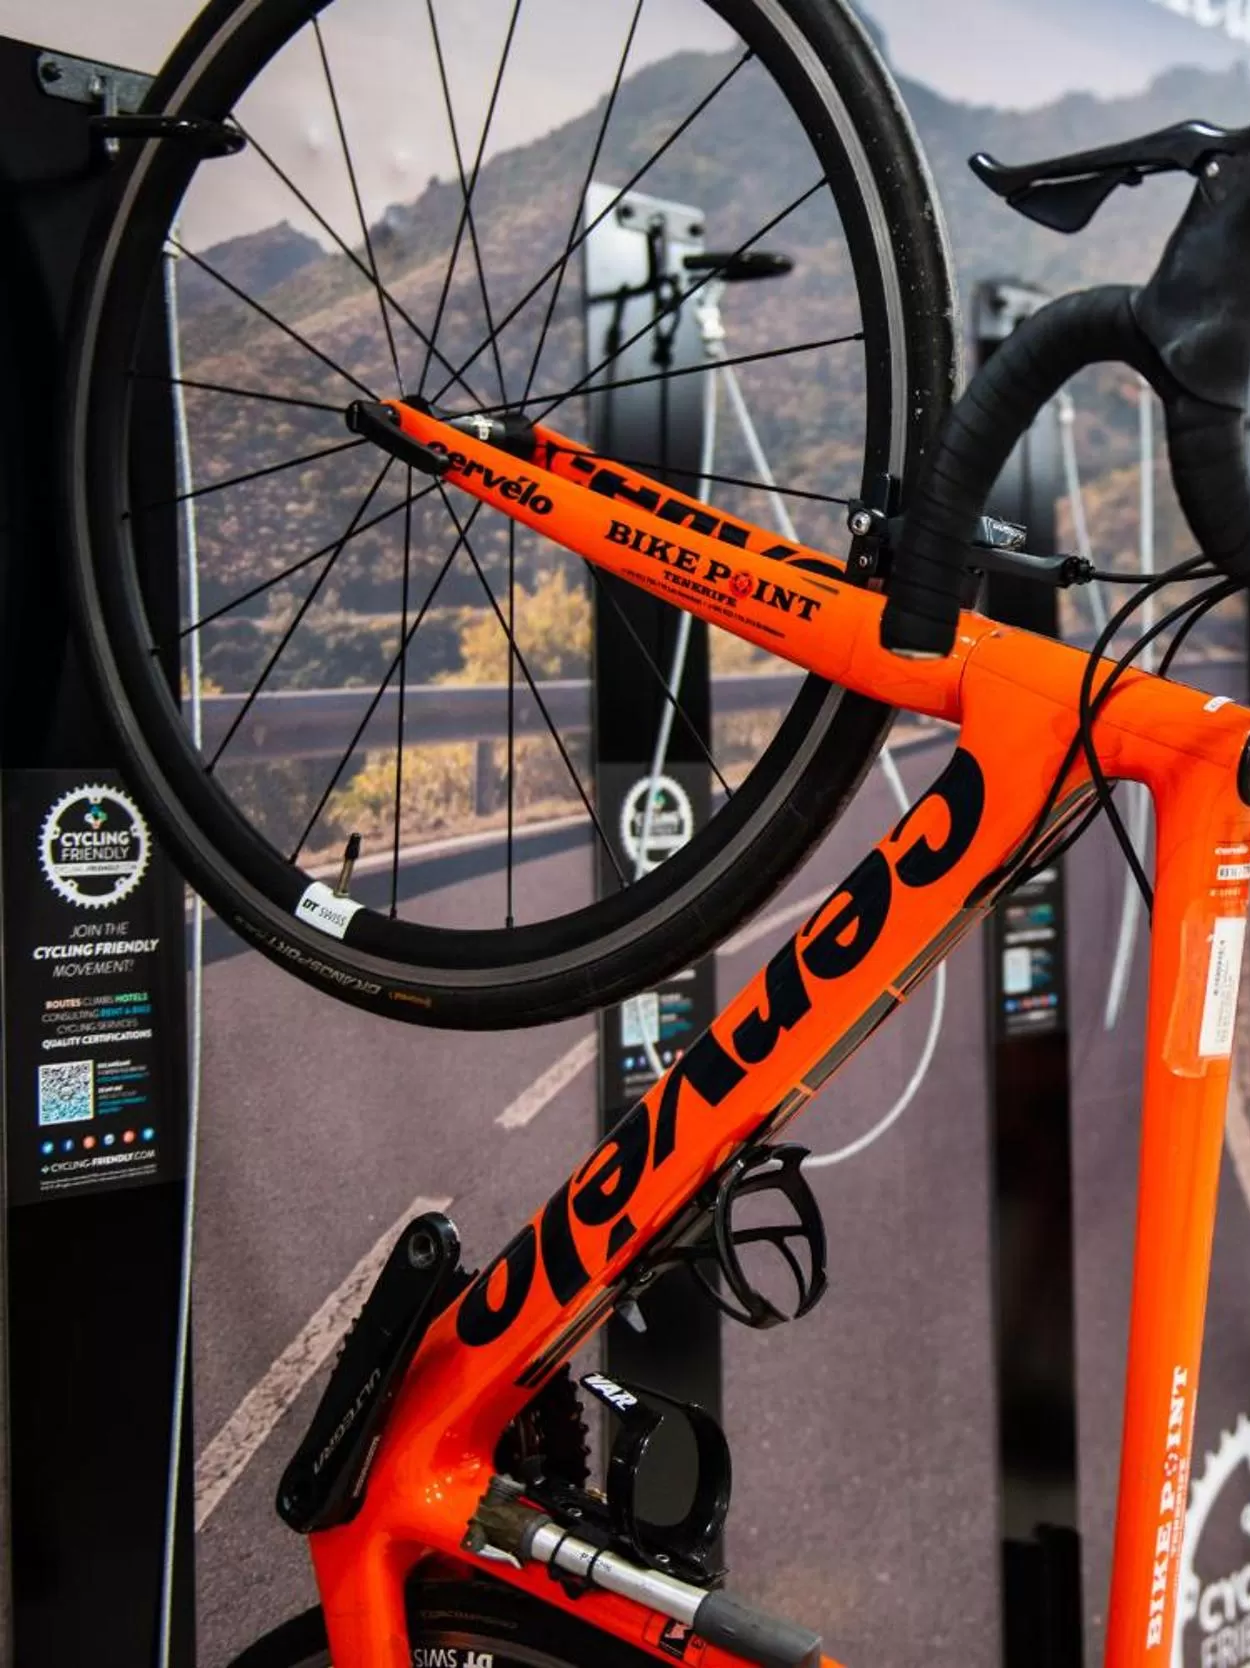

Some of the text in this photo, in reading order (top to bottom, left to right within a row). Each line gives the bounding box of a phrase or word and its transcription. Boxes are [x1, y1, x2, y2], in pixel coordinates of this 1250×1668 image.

[604, 519, 701, 574] BIKE
[703, 558, 822, 622] POINT
[663, 569, 737, 607] TENERIFE
[60, 831, 130, 847] CYCLING
[61, 846, 131, 861] FRIENDLY
[301, 897, 347, 927] DT SWISS
[69, 921, 130, 939] JOIN THE
[33, 938, 160, 960] CYCLING FRIENDLY
[52, 959, 135, 978] MOVEMENT!
[45, 997, 81, 1009] ROUTES
[114, 992, 148, 1003] HOTELS
[41, 1029, 152, 1050] QUALITY CERTIFICATIONS
[456, 747, 985, 1347] cervélo
[584, 1372, 638, 1412] VAR
[1145, 1521, 1171, 1651] BIKE
[1158, 1364, 1188, 1517] POINT
